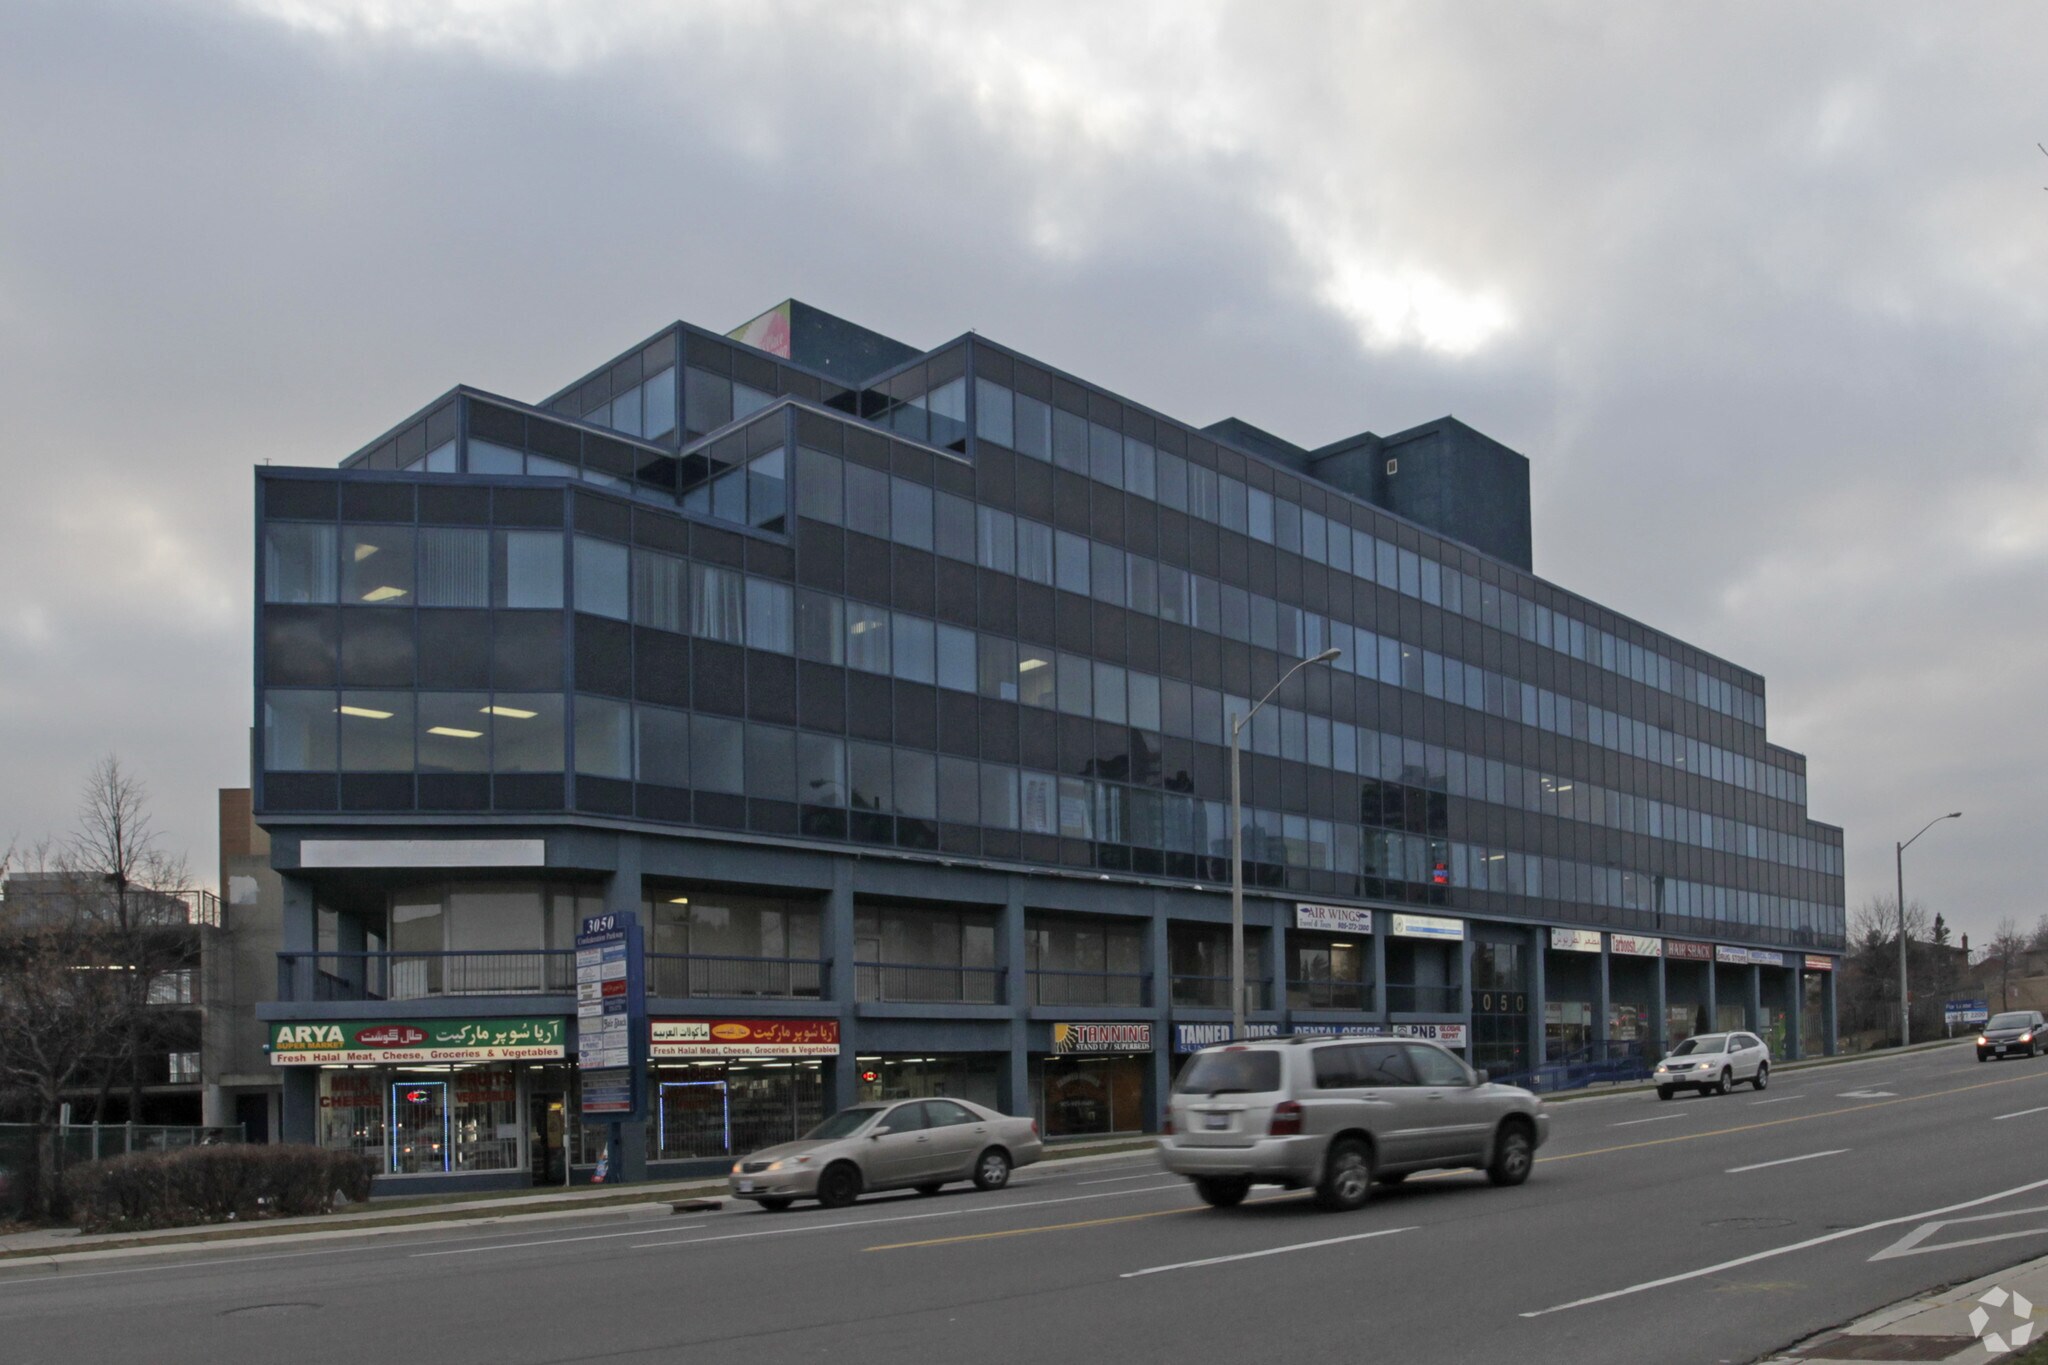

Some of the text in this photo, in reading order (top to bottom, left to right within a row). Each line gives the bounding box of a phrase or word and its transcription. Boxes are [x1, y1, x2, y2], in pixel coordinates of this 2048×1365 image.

[1308, 907, 1361, 922] AIR WINGS
[586, 916, 614, 934] 3050
[1669, 943, 1686, 956] HAIR
[1687, 944, 1711, 958] SHACK
[277, 1026, 345, 1043] ARYA
[1076, 1025, 1150, 1043] TANNING
[1179, 1024, 1230, 1044] TANNED
[1411, 1025, 1437, 1038] PNB
[276, 1041, 345, 1050] SUPER MARKET
[653, 1046, 675, 1055] Fresh
[678, 1046, 698, 1055] Halal
[700, 1047, 720, 1056] Meat,
[723, 1046, 752, 1055] Cheese,
[755, 1046, 789, 1054] Groceries
[799, 1046, 837, 1055] Vegetables
[1076, 1043, 1098, 1051] STAND
[277, 1048, 559, 1063] Fresh Halal Meat, Cheese, Groceries & Vegetables
[320, 1095, 383, 1108] CHEESE
